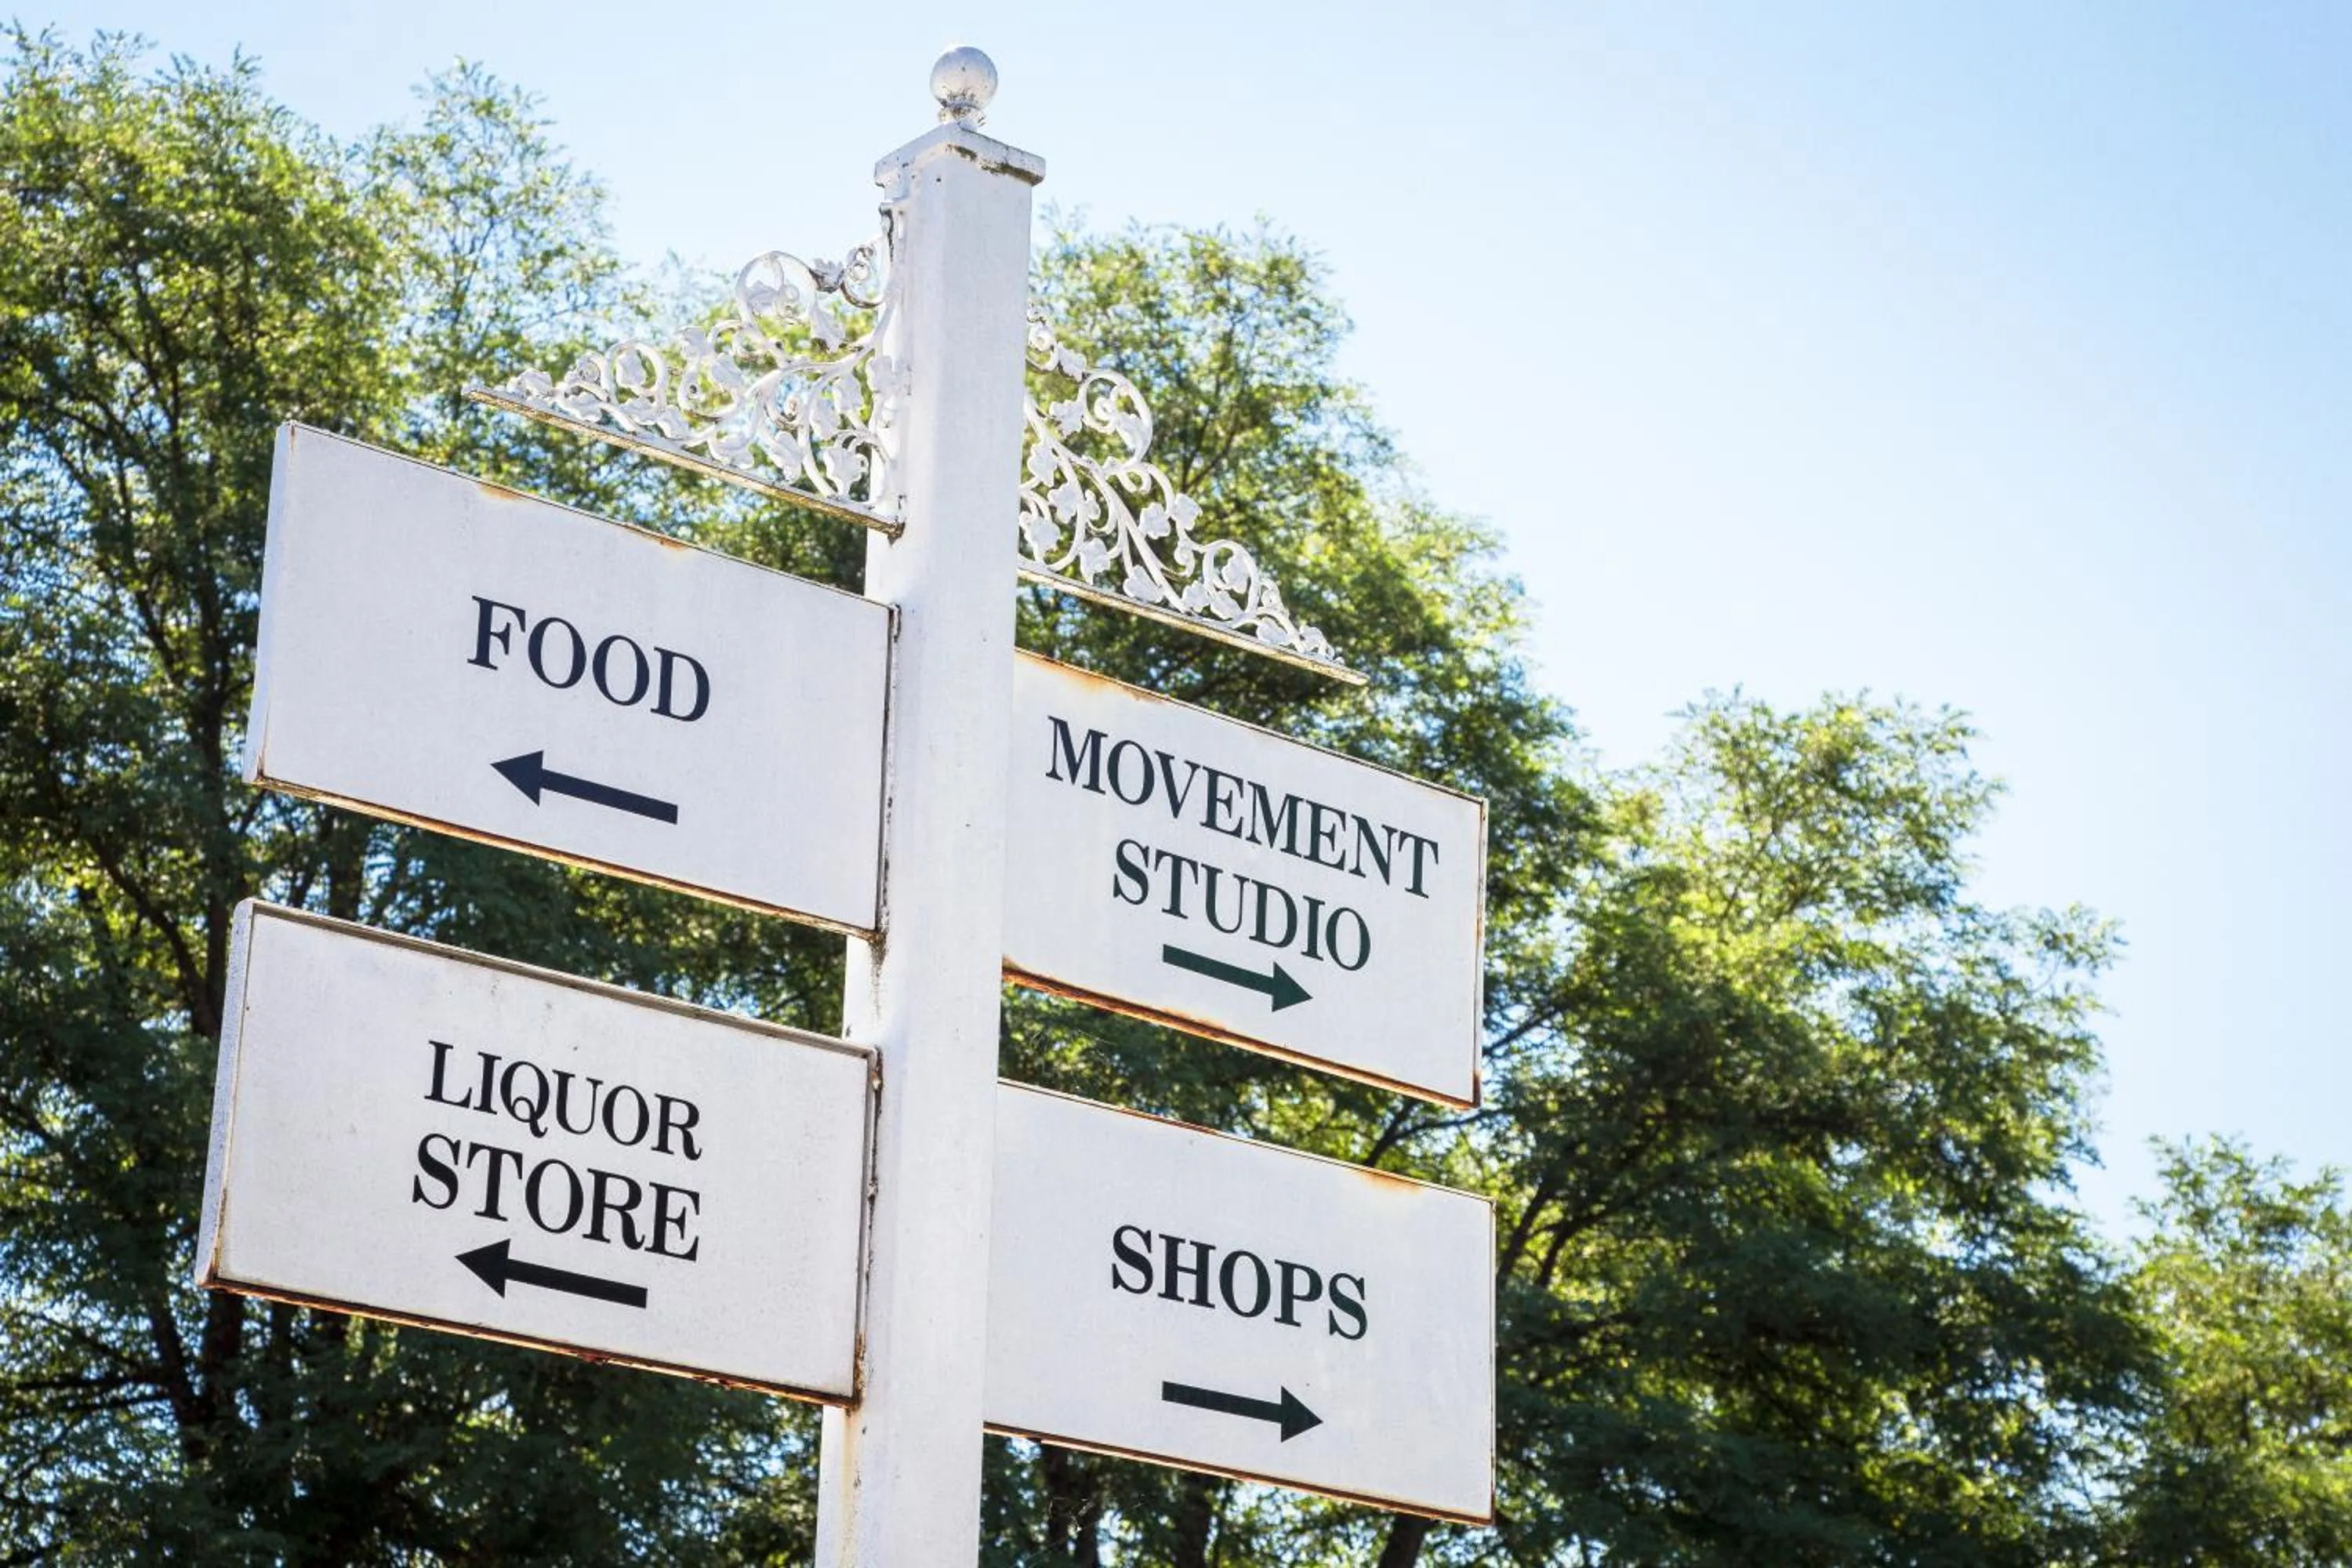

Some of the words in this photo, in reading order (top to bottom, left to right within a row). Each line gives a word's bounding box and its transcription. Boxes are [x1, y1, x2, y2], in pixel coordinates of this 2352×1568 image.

[466, 595, 710, 722] FOOD
[1045, 716, 1439, 899] MOVEMENT
[1112, 838, 1371, 971] STUDIO
[423, 1040, 702, 1161] LIQUOR
[412, 1133, 700, 1262] STORE
[1111, 1225, 1368, 1341] SHOPS
